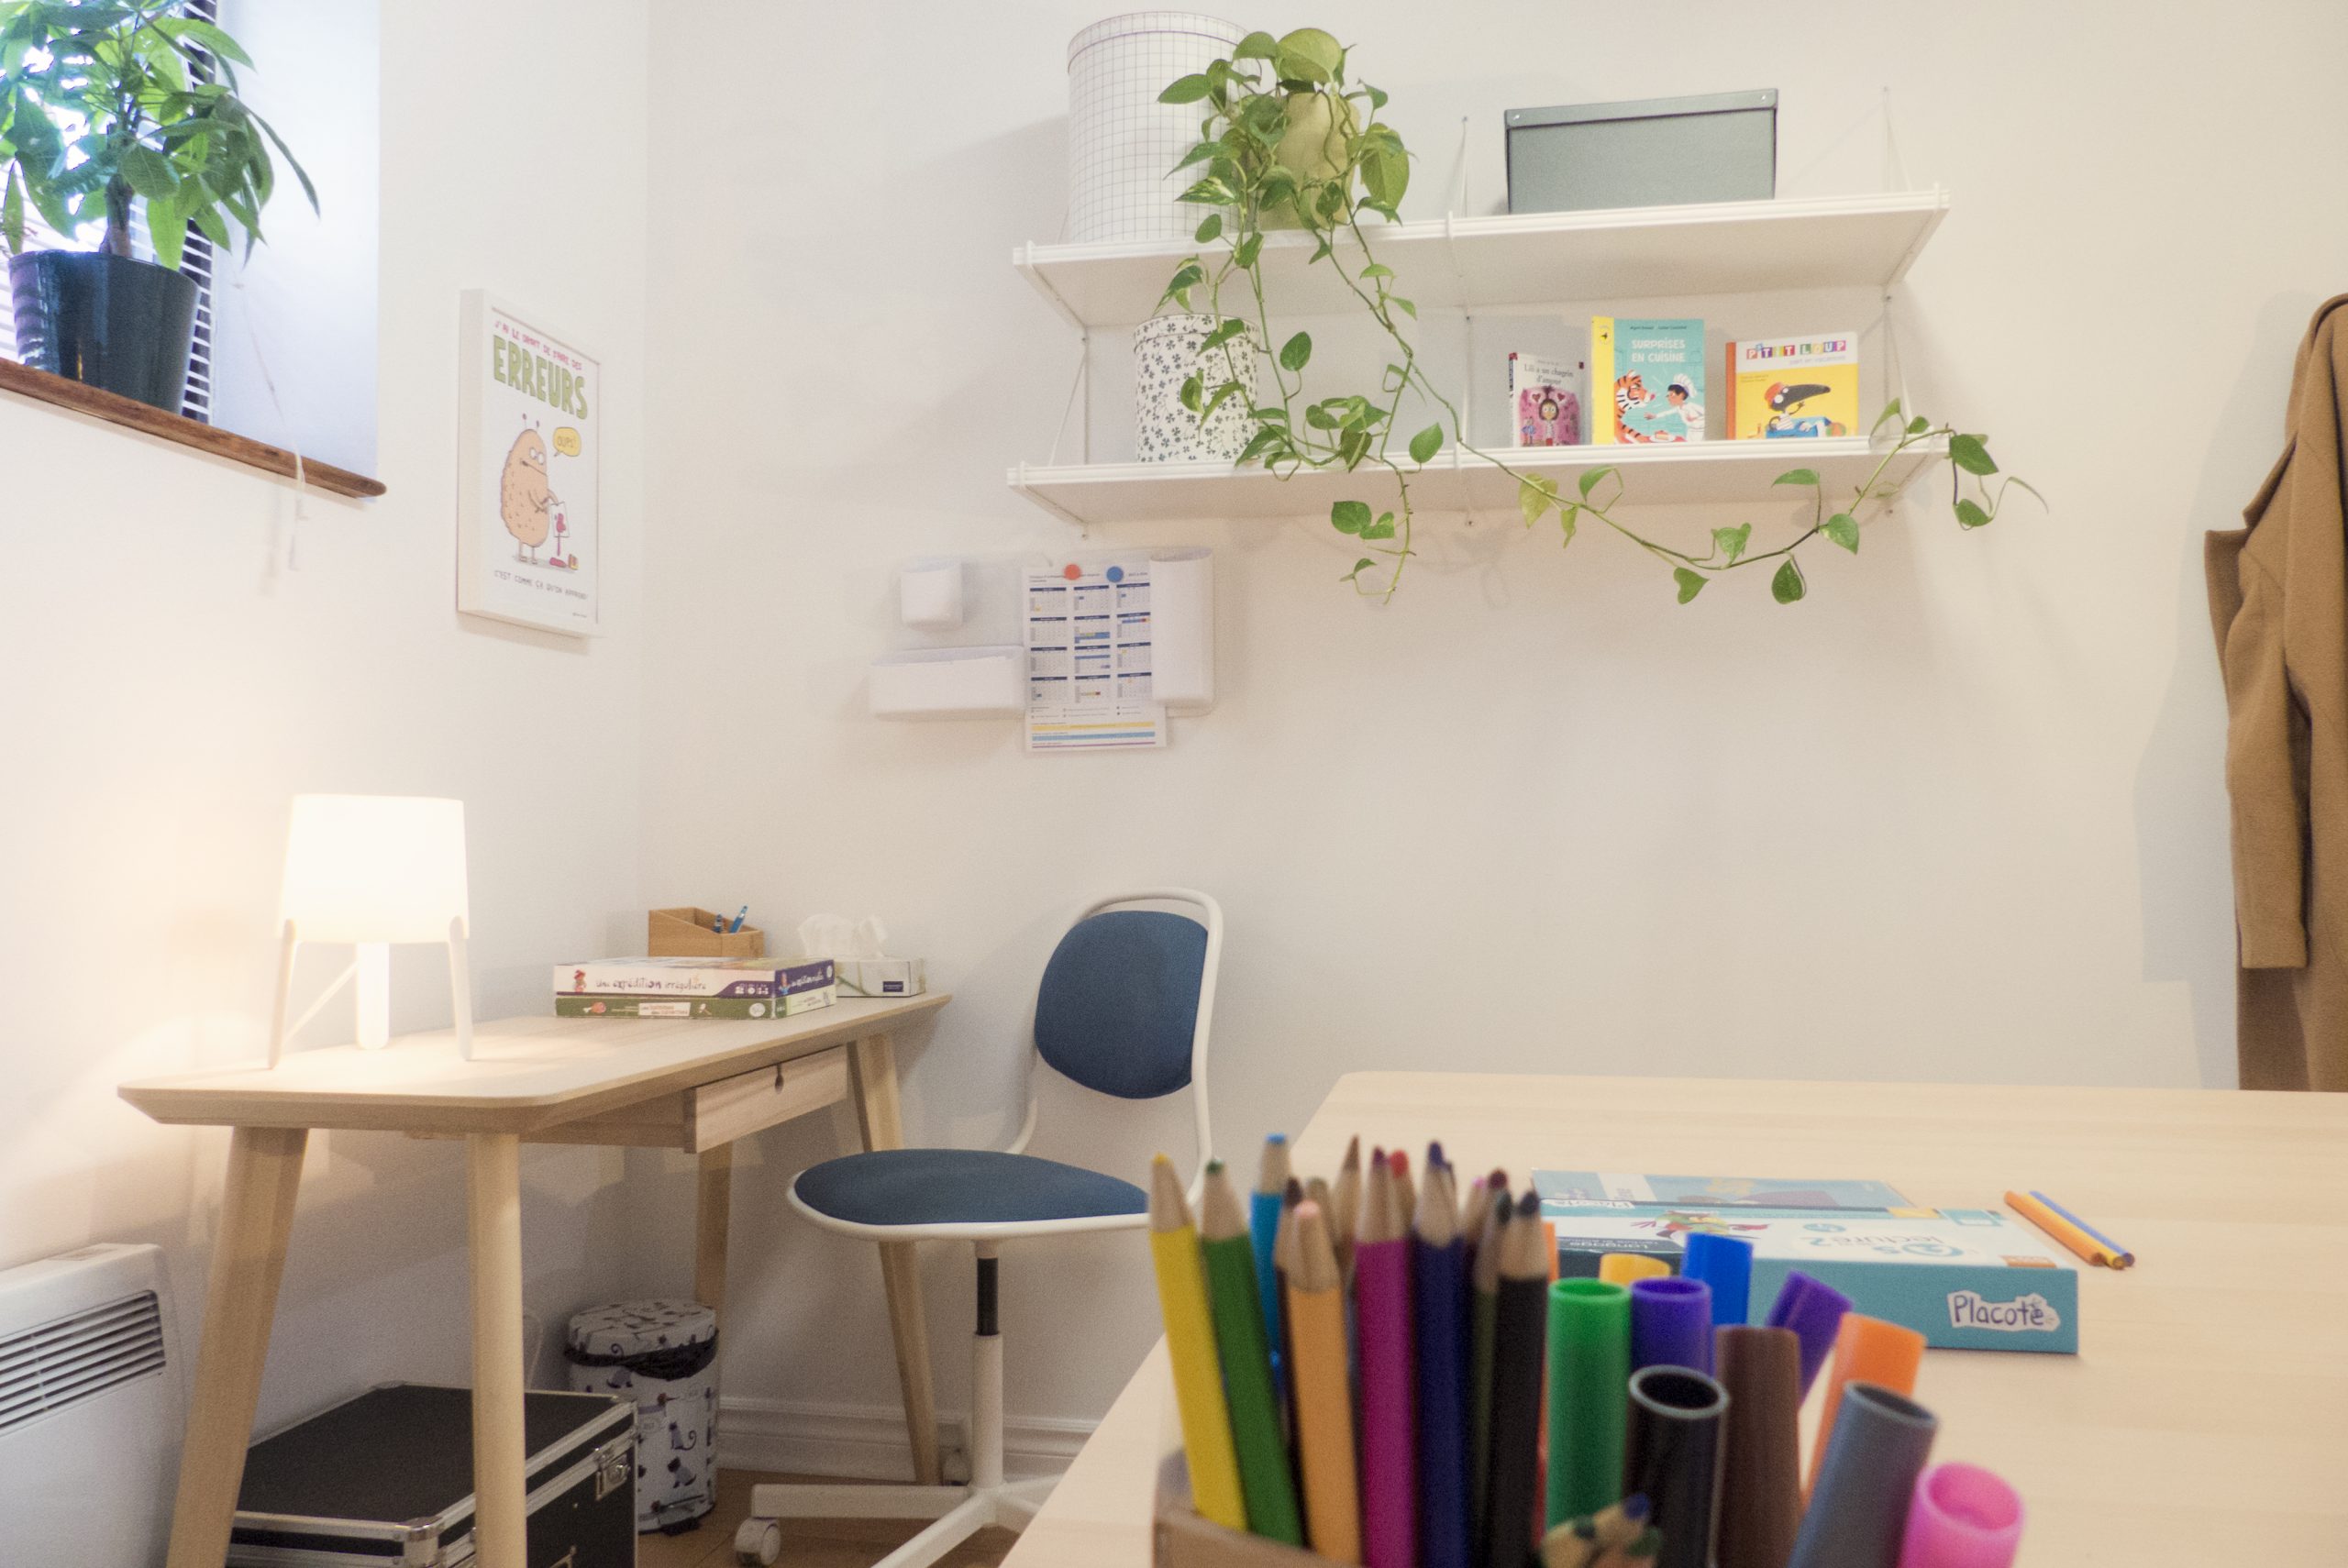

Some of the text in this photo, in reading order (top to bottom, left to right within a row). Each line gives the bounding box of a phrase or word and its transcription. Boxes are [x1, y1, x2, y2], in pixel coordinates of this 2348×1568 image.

[512, 327, 520, 340] LE
[523, 335, 540, 348] DROIT
[543, 344, 551, 357] DE
[552, 350, 570, 366] FAIRE
[1800, 339, 1847, 356] LOUP
[1632, 351, 1645, 363] EN
[493, 334, 588, 420] ERREURS
[1551, 367, 1574, 378] chagrin
[515, 575, 531, 587] COMME
